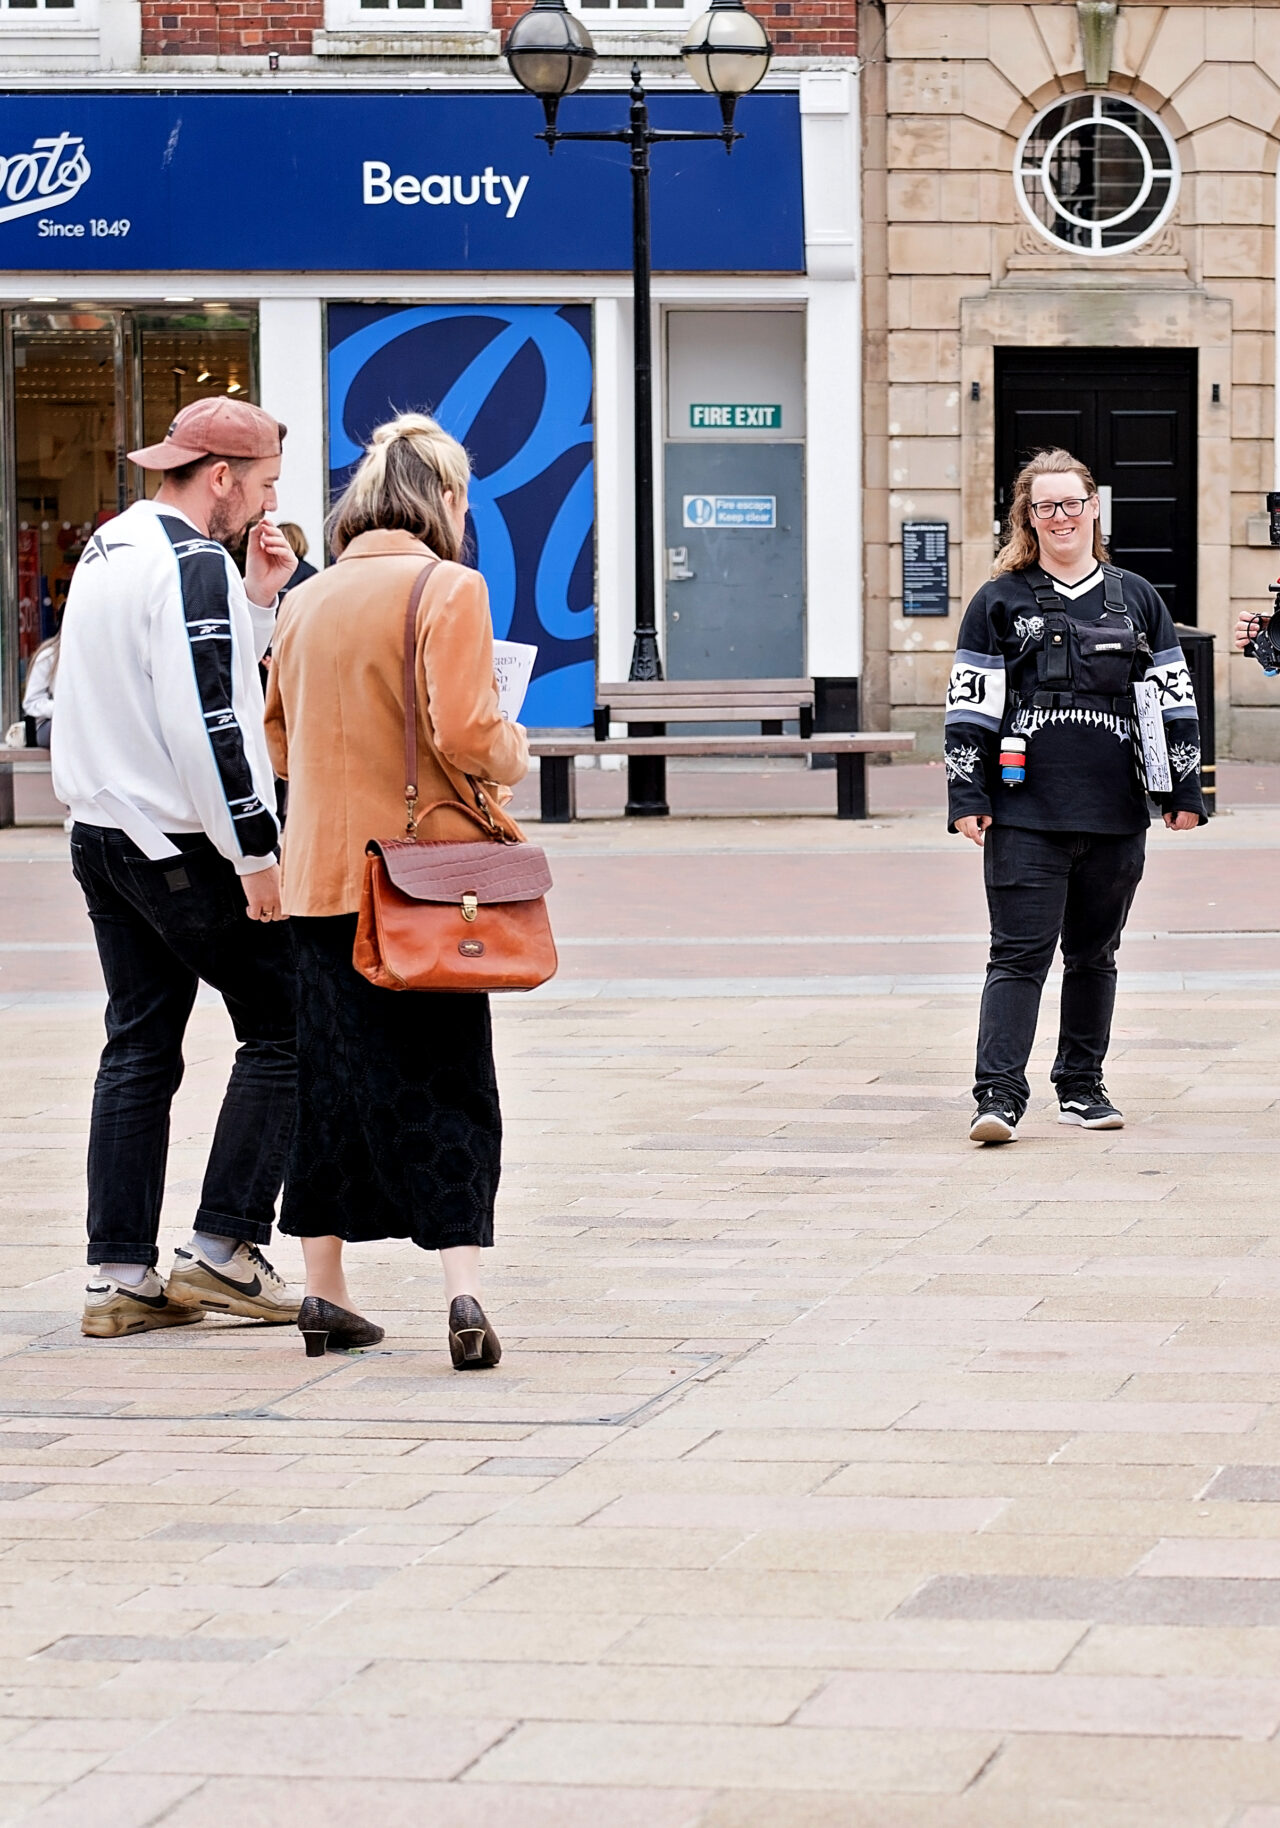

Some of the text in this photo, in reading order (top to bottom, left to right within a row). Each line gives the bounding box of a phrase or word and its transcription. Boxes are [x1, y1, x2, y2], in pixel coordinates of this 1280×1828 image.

[0, 131, 91, 222] ots
[362, 160, 531, 219] Beauty
[38, 218, 131, 237] Since 1849
[693, 406, 775, 426] FIRE EXIT
[717, 500, 771, 511] Fire escape
[718, 513, 770, 523] Keep clear
